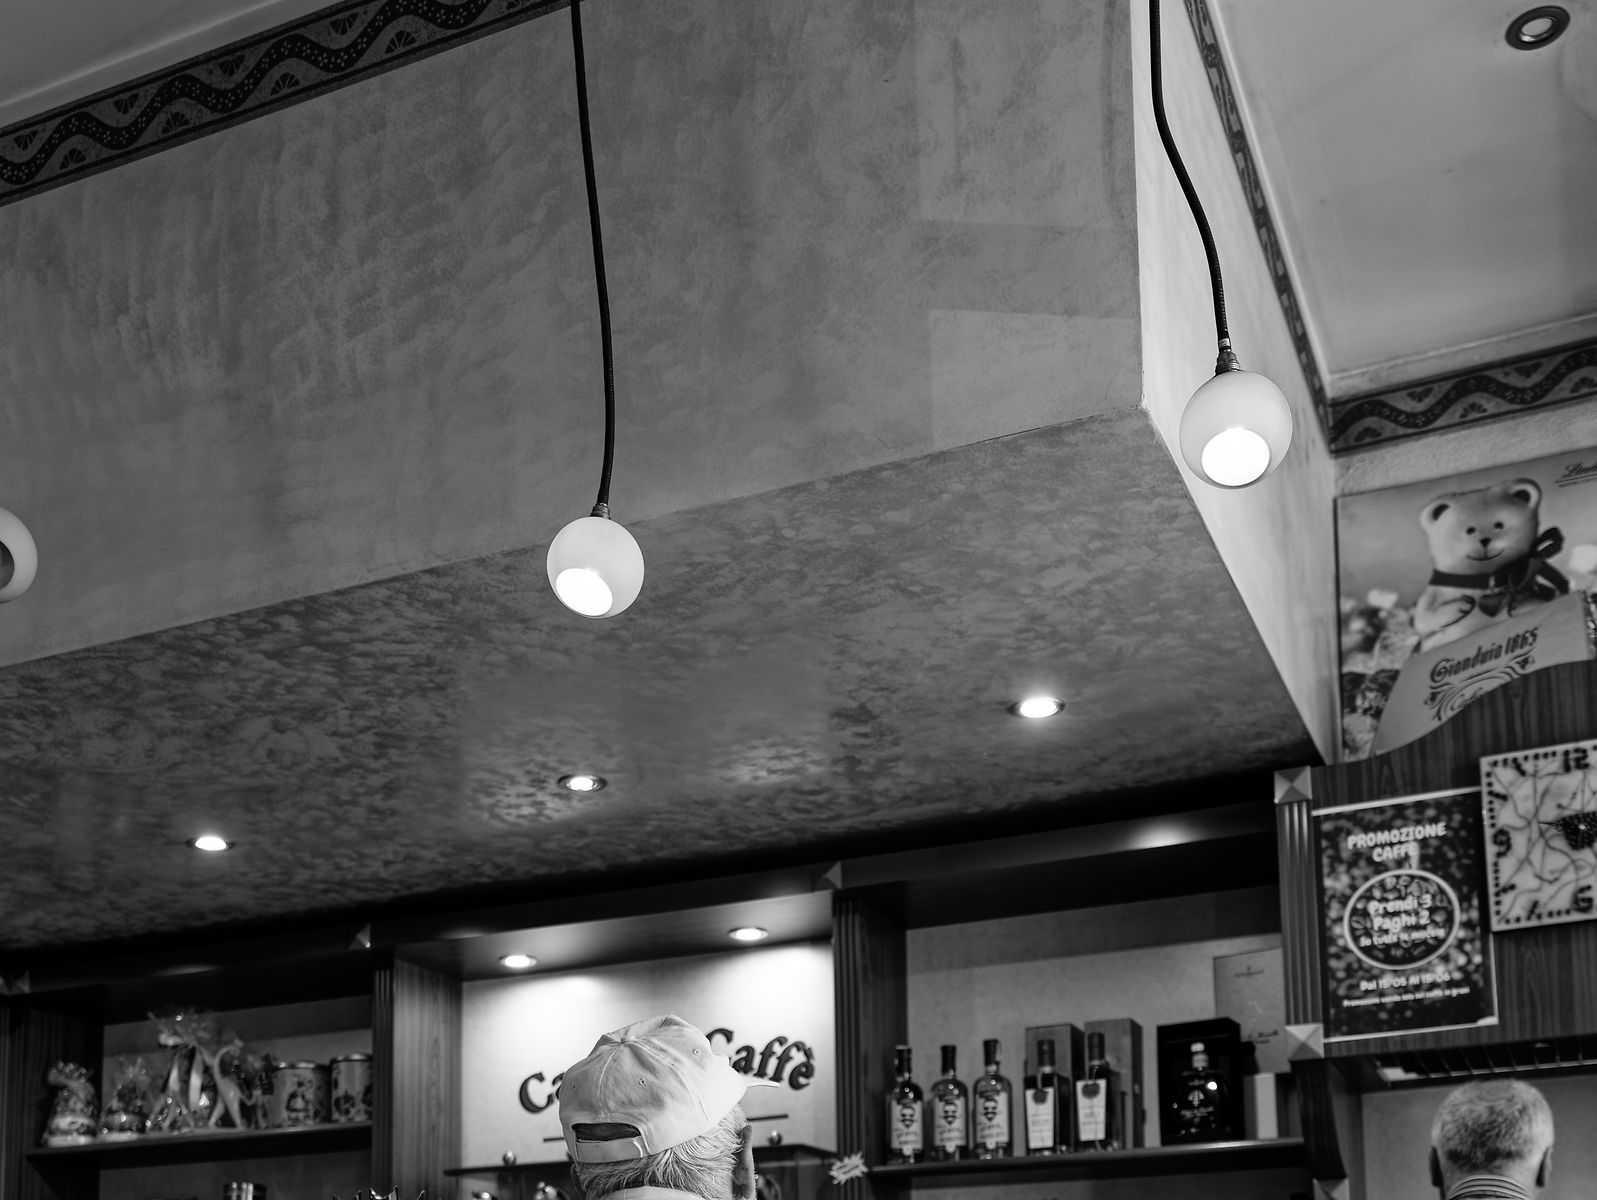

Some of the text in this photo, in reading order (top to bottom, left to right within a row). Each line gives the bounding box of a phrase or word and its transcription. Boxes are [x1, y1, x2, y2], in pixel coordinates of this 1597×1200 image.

[1562, 747, 1591, 773] 12
[1346, 821, 1448, 850] PROMOZIONE
[1492, 828, 1513, 858] 9
